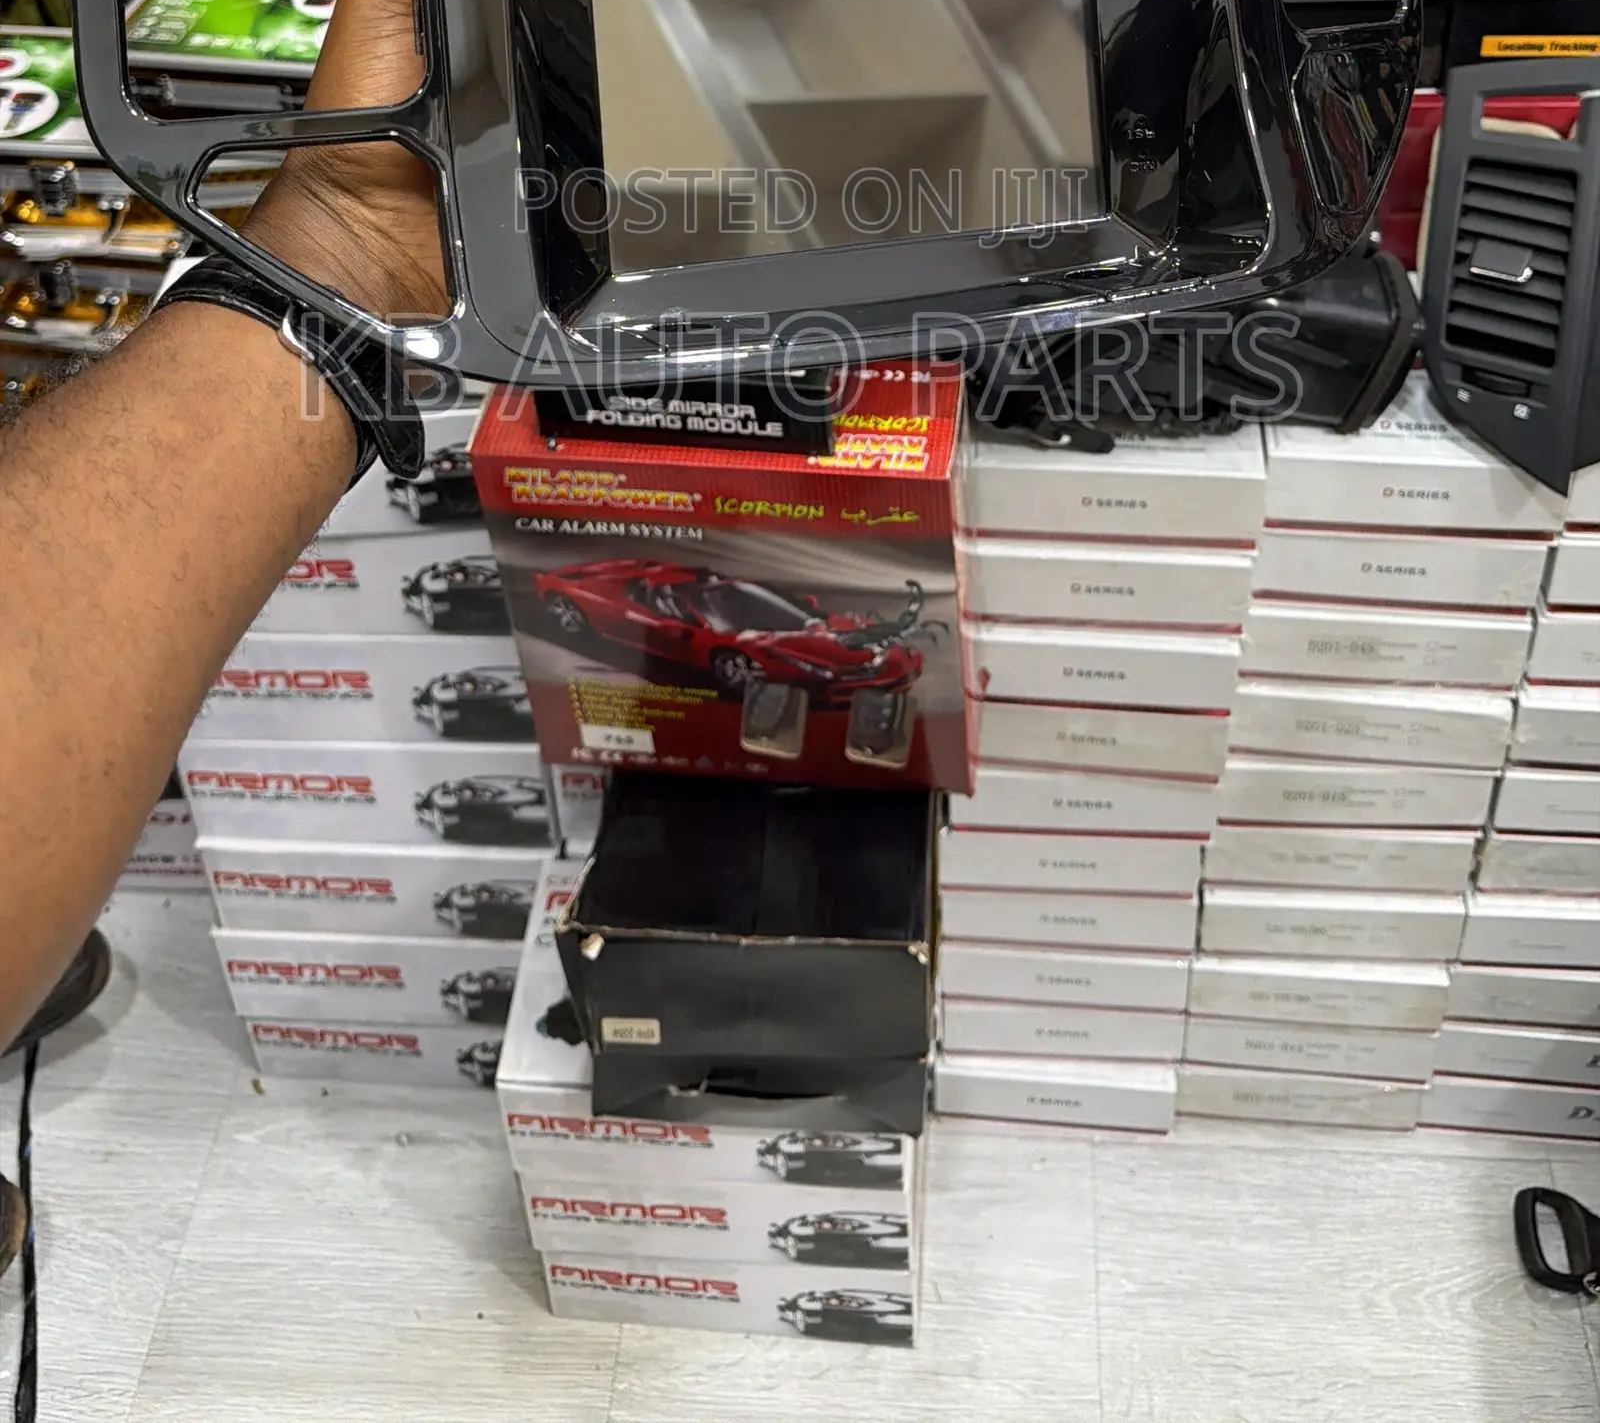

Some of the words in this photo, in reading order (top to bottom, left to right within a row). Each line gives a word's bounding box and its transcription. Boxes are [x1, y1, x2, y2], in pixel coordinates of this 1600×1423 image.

[608, 396, 664, 414] SIDE
[667, 399, 757, 420] MIRROR
[586, 409, 682, 430] FOLDING
[686, 417, 785, 438] MODULE
[512, 483, 696, 513] ROADPOWER
[714, 494, 825, 521] SCORPION
[1398, 488, 1451, 500] SERIES
[514, 517, 554, 533] CAR
[558, 519, 626, 537] ALARM
[628, 521, 704, 541] SYSTEM
[187, 771, 373, 795] ARMOR
[213, 870, 394, 896] ARMOR
[227, 960, 402, 983] ARMOR
[253, 1024, 420, 1050] ARMOR
[507, 1113, 713, 1143] ARMOR
[531, 1196, 728, 1224] ARMOR
[550, 1265, 739, 1296] ARMOR
